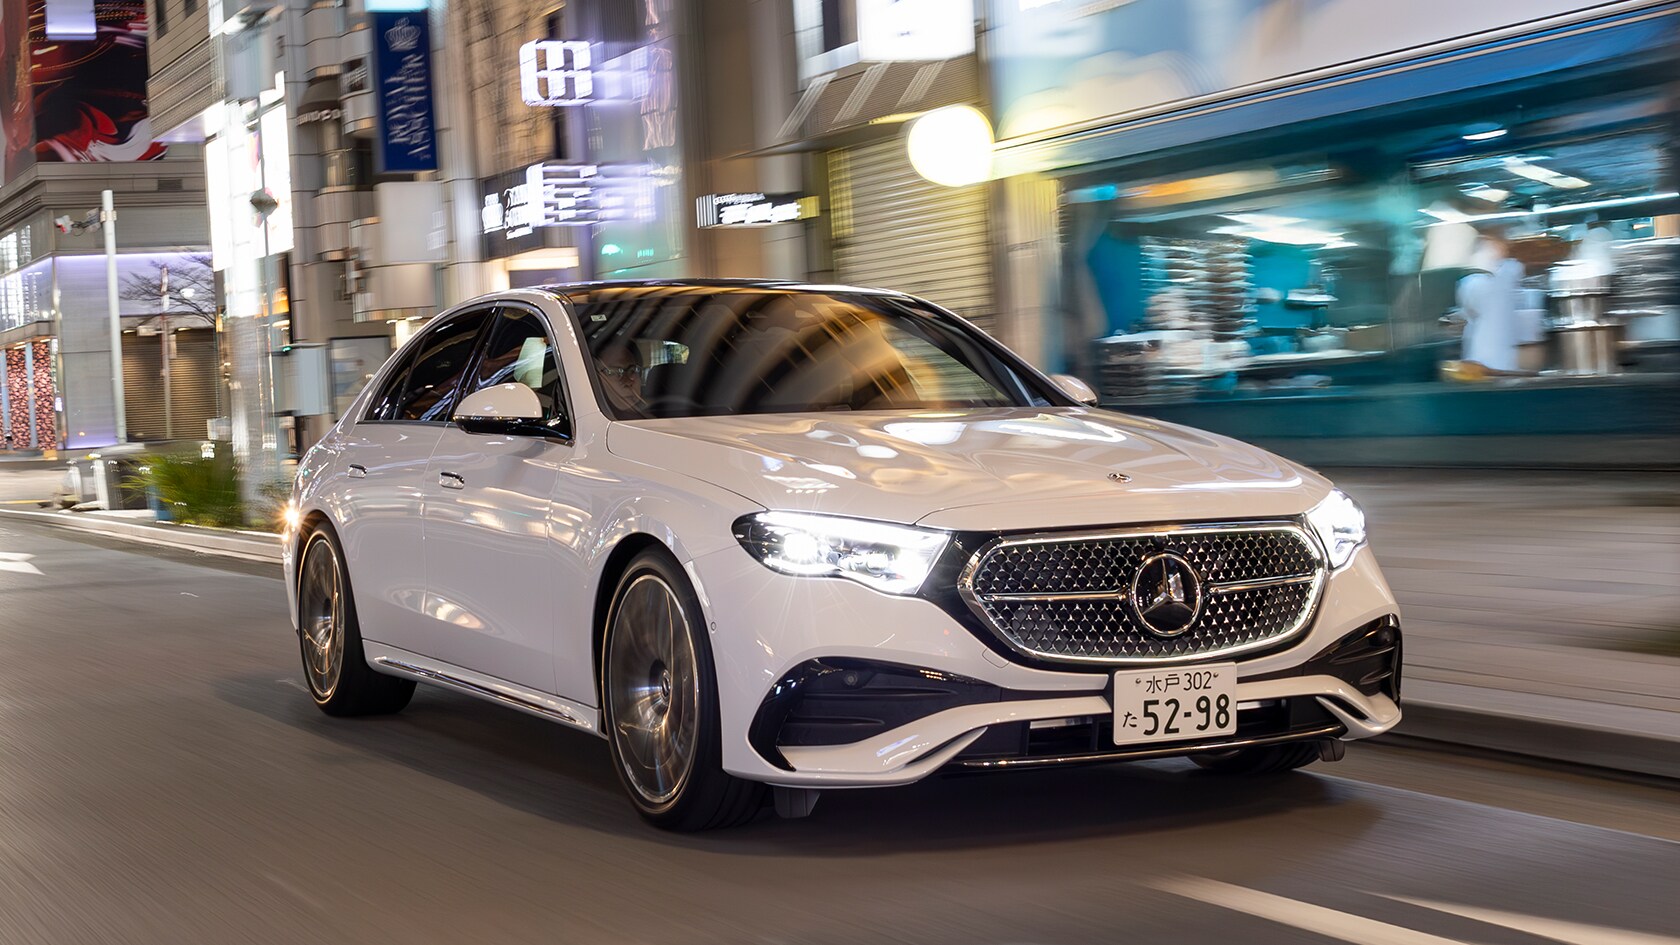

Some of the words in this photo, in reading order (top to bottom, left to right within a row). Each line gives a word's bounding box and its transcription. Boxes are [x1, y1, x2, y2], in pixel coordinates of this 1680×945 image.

[1145, 673, 1180, 694] 水戸
[1183, 671, 1212, 691] 302
[1122, 711, 1138, 728] た
[1143, 693, 1230, 736] 52-98
